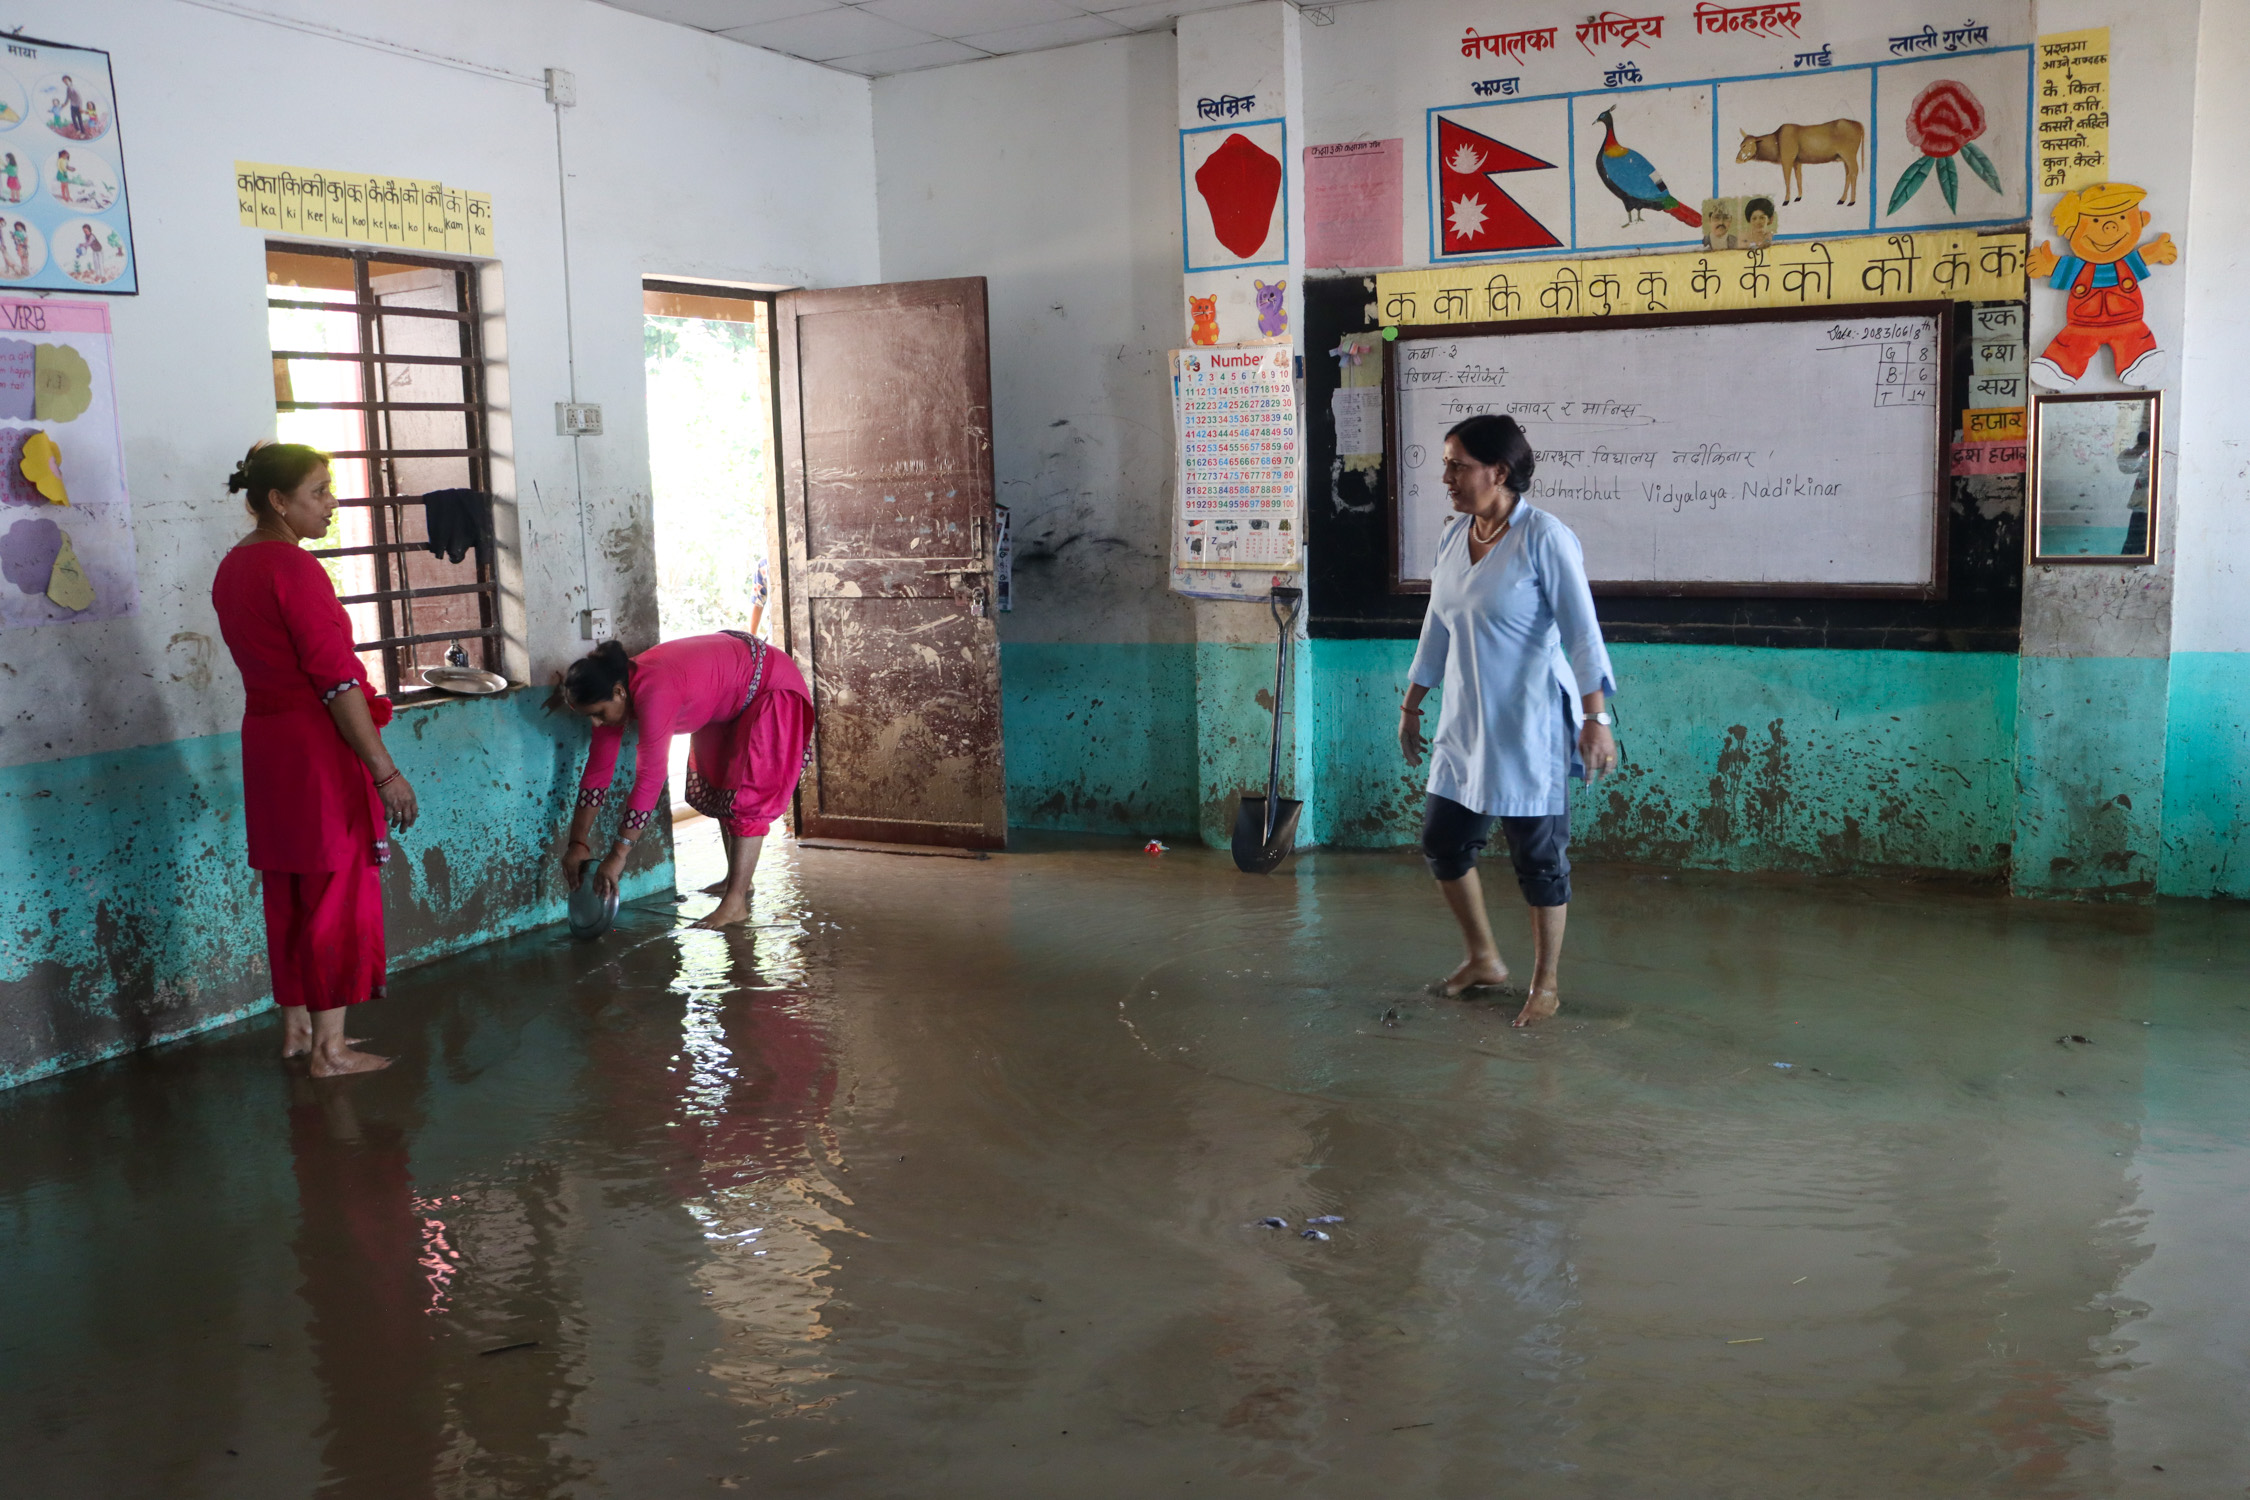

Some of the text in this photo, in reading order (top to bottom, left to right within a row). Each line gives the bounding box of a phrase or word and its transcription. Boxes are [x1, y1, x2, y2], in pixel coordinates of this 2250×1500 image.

[1461, 27, 1558, 66] नेपालका
[1888, 24, 1938, 56] लाली
[7, 44, 37, 59] माया
[1793, 43, 1833, 68] गाई
[1196, 94, 1256, 122] सिम्रिक
[1386, 292, 1416, 320] क
[1434, 288, 1473, 320] का
[1485, 274, 1521, 318] कि
[1540, 267, 1582, 314] की
[1589, 274, 1621, 317] कु
[1636, 272, 1668, 311] कू
[1690, 258, 1720, 300] के
[1740, 249, 1770, 298] कै
[1780, 242, 1834, 302] को
[1862, 234, 1922, 296] कौ
[1932, 243, 1970, 290] कं
[1, 304, 46, 331] VERB
[1978, 310, 2016, 331] एक
[1919, 347, 1928, 361] 8
[1886, 366, 1928, 384] B 6
[1881, 390, 1926, 405] T 14
[1976, 378, 2021, 398] सय
[1196, 402, 1206, 410] 22
[1250, 400, 1259, 408] 27
[1271, 399, 1280, 407] 29
[1282, 399, 1291, 407] 30
[1581, 399, 1642, 418] मानिस
[1971, 412, 2024, 432] हजार
[1196, 430, 1206, 438] 42
[1229, 429, 1239, 437] 45
[1271, 428, 1281, 436] 49
[1207, 458, 1218, 466] 63
[1218, 458, 1228, 466] 64
[1229, 458, 1239, 466] 65
[1260, 457, 1270, 465] 68
[1207, 486, 1218, 494] 83
[1218, 486, 1228, 494] 84
[1229, 486, 1239, 494] 85
[1283, 485, 1293, 493] 90
